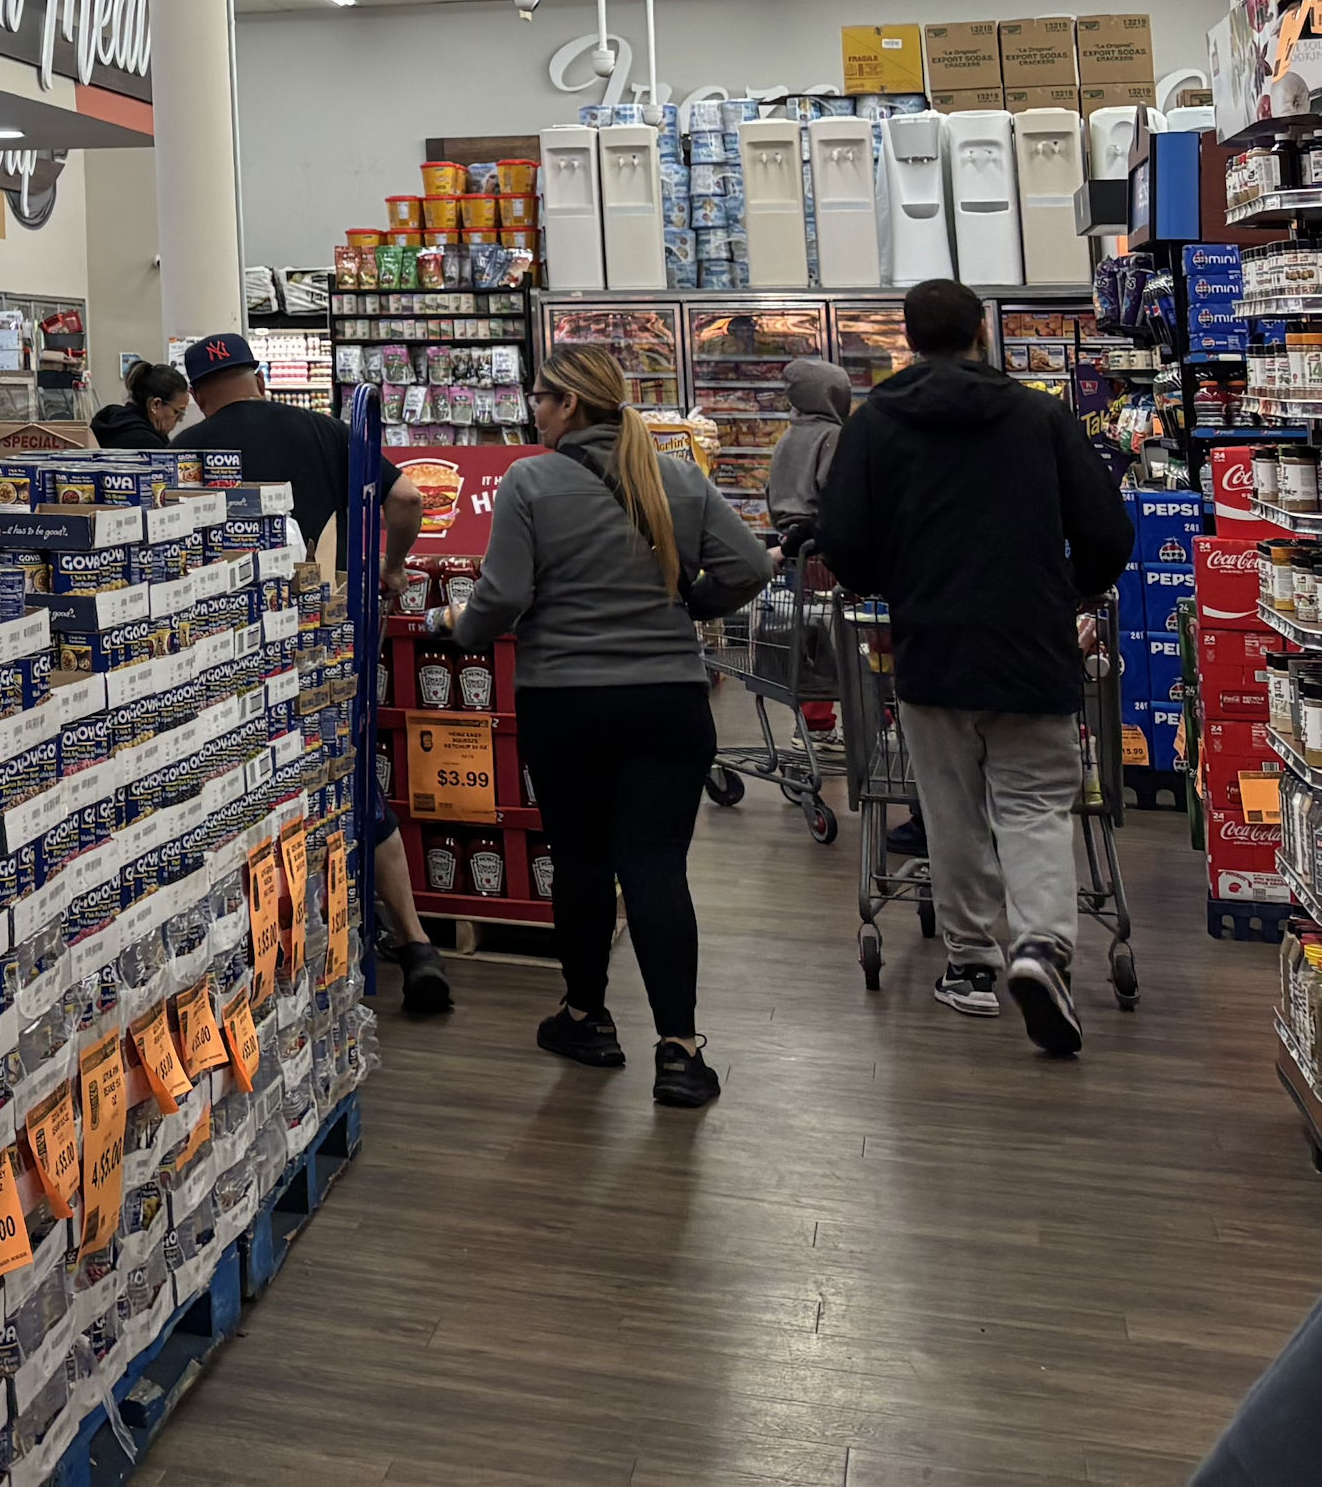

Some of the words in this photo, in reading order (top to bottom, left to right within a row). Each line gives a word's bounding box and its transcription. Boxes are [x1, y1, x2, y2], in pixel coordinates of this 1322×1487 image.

[932, 56, 962, 64] EXPORT
[1006, 54, 1037, 62] EXPORT
[1208, 253, 1236, 264] mini
[1211, 283, 1239, 294] mini
[3, 435, 59, 449] SPECIAL
[206, 454, 240, 467] GOYA
[1142, 503, 1199, 516] PEPSI
[226, 521, 259, 534] GOYA
[1199, 542, 1211, 550] 24
[61, 555, 101, 572] GOYA
[1147, 572, 1194, 586] PEPS
[437, 769, 489, 788] $3.99
